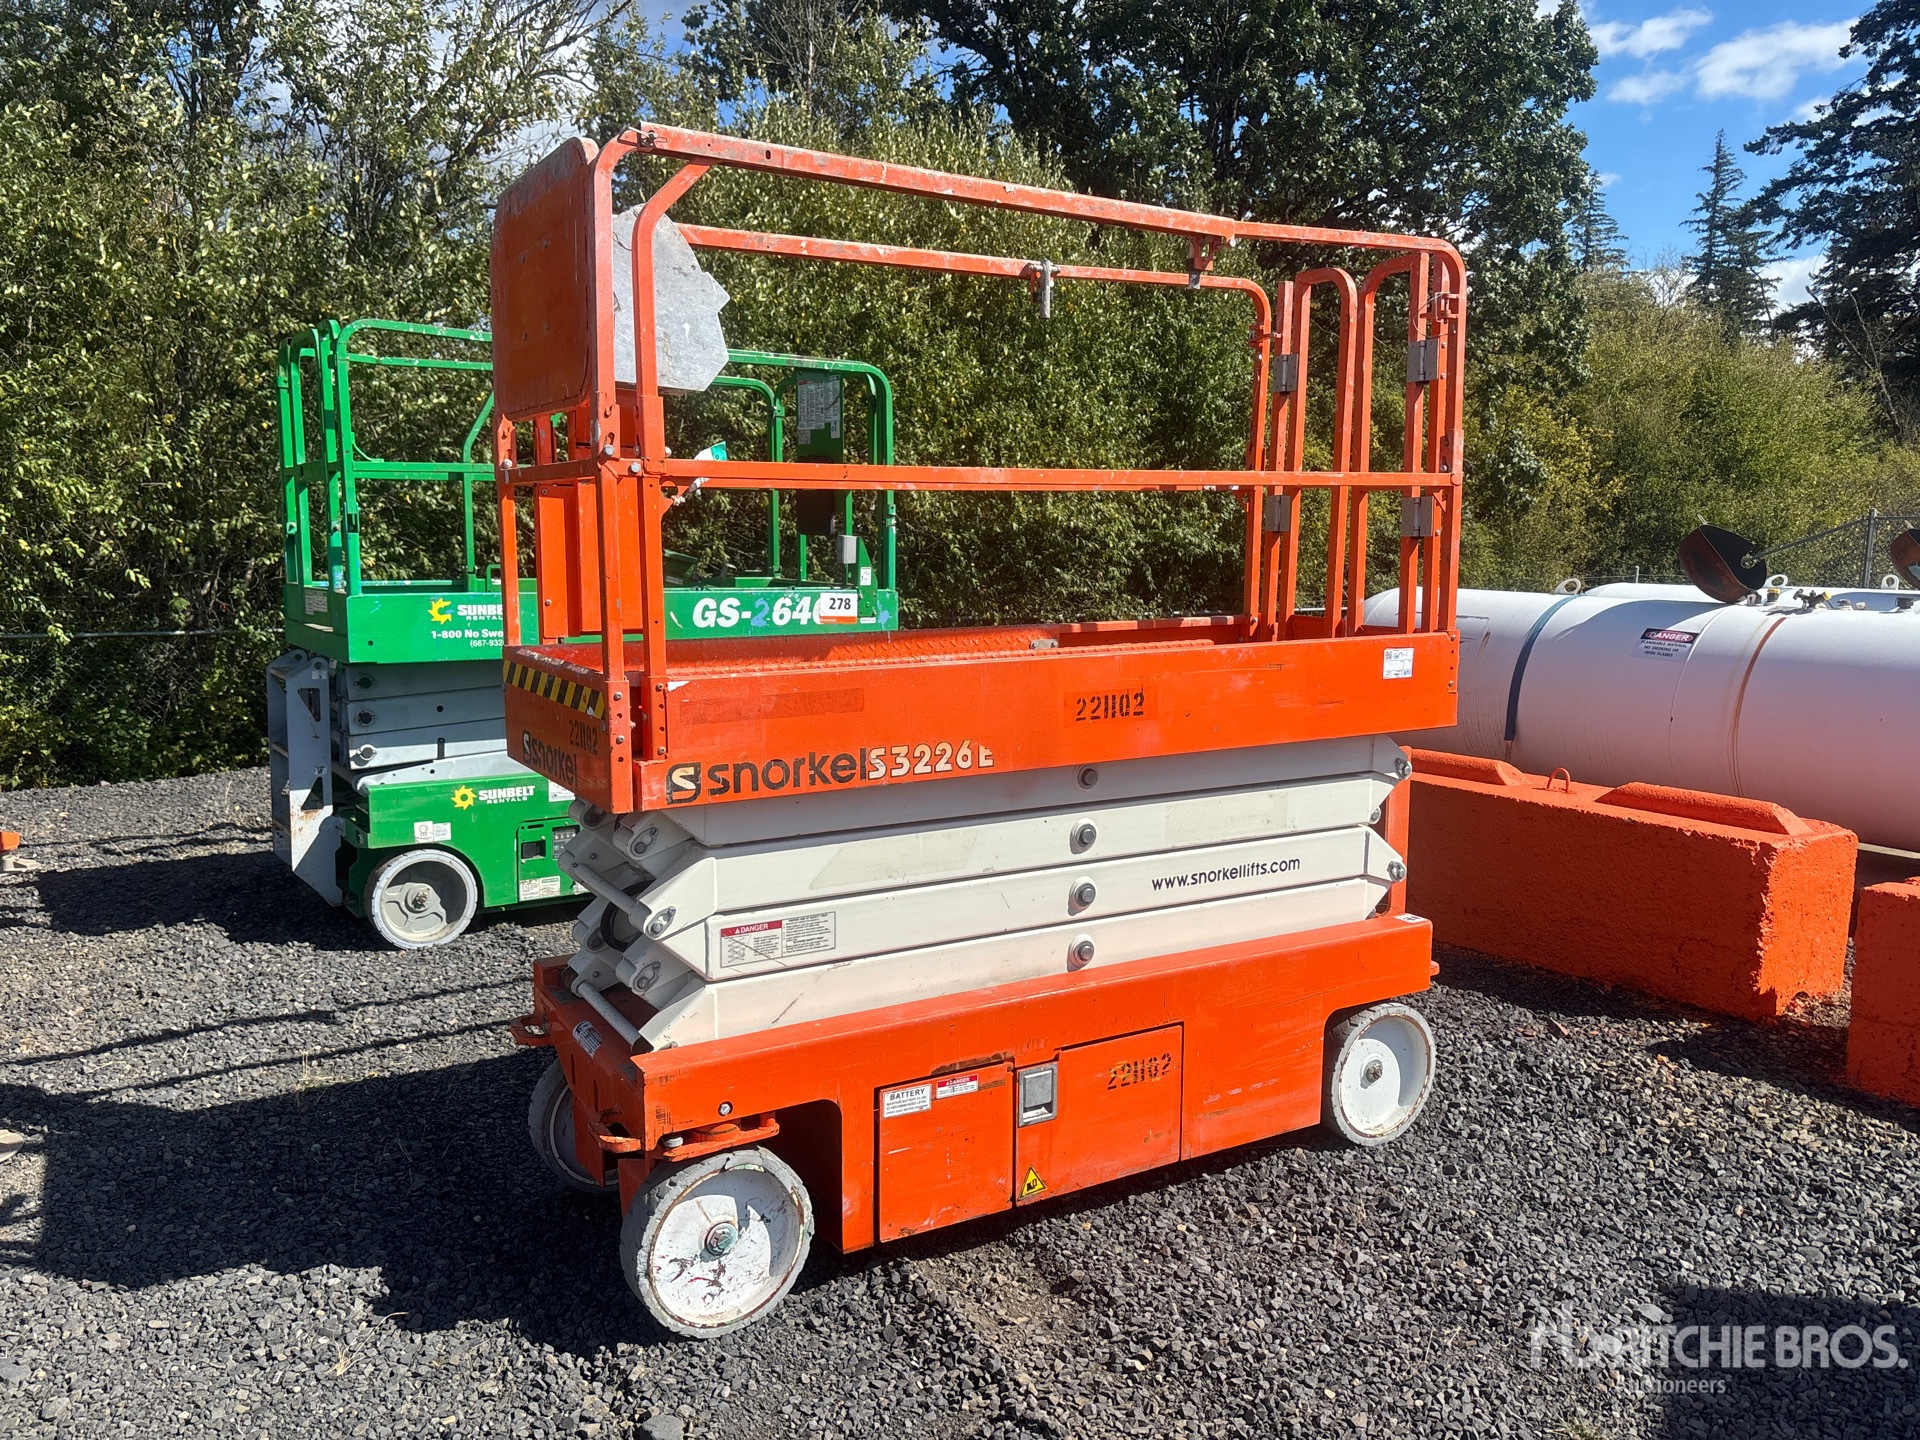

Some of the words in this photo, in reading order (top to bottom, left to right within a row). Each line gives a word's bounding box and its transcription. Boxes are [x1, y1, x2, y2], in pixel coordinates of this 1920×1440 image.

[829, 597, 851, 610] 278
[431, 630, 463, 639] 1-800
[464, 629, 480, 638] No
[1649, 631, 1690, 641] DANGER
[1076, 691, 1145, 722] 221102
[532, 737, 578, 788] snorkel
[707, 747, 865, 796] snorkel
[478, 785, 535, 801] SUNBELT
[486, 796, 528, 805] RENTALS
[1152, 858, 1301, 891] www.snorkellifts.com
[740, 923, 768, 934] DANGER
[890, 1088, 925, 1100] BATTERY
